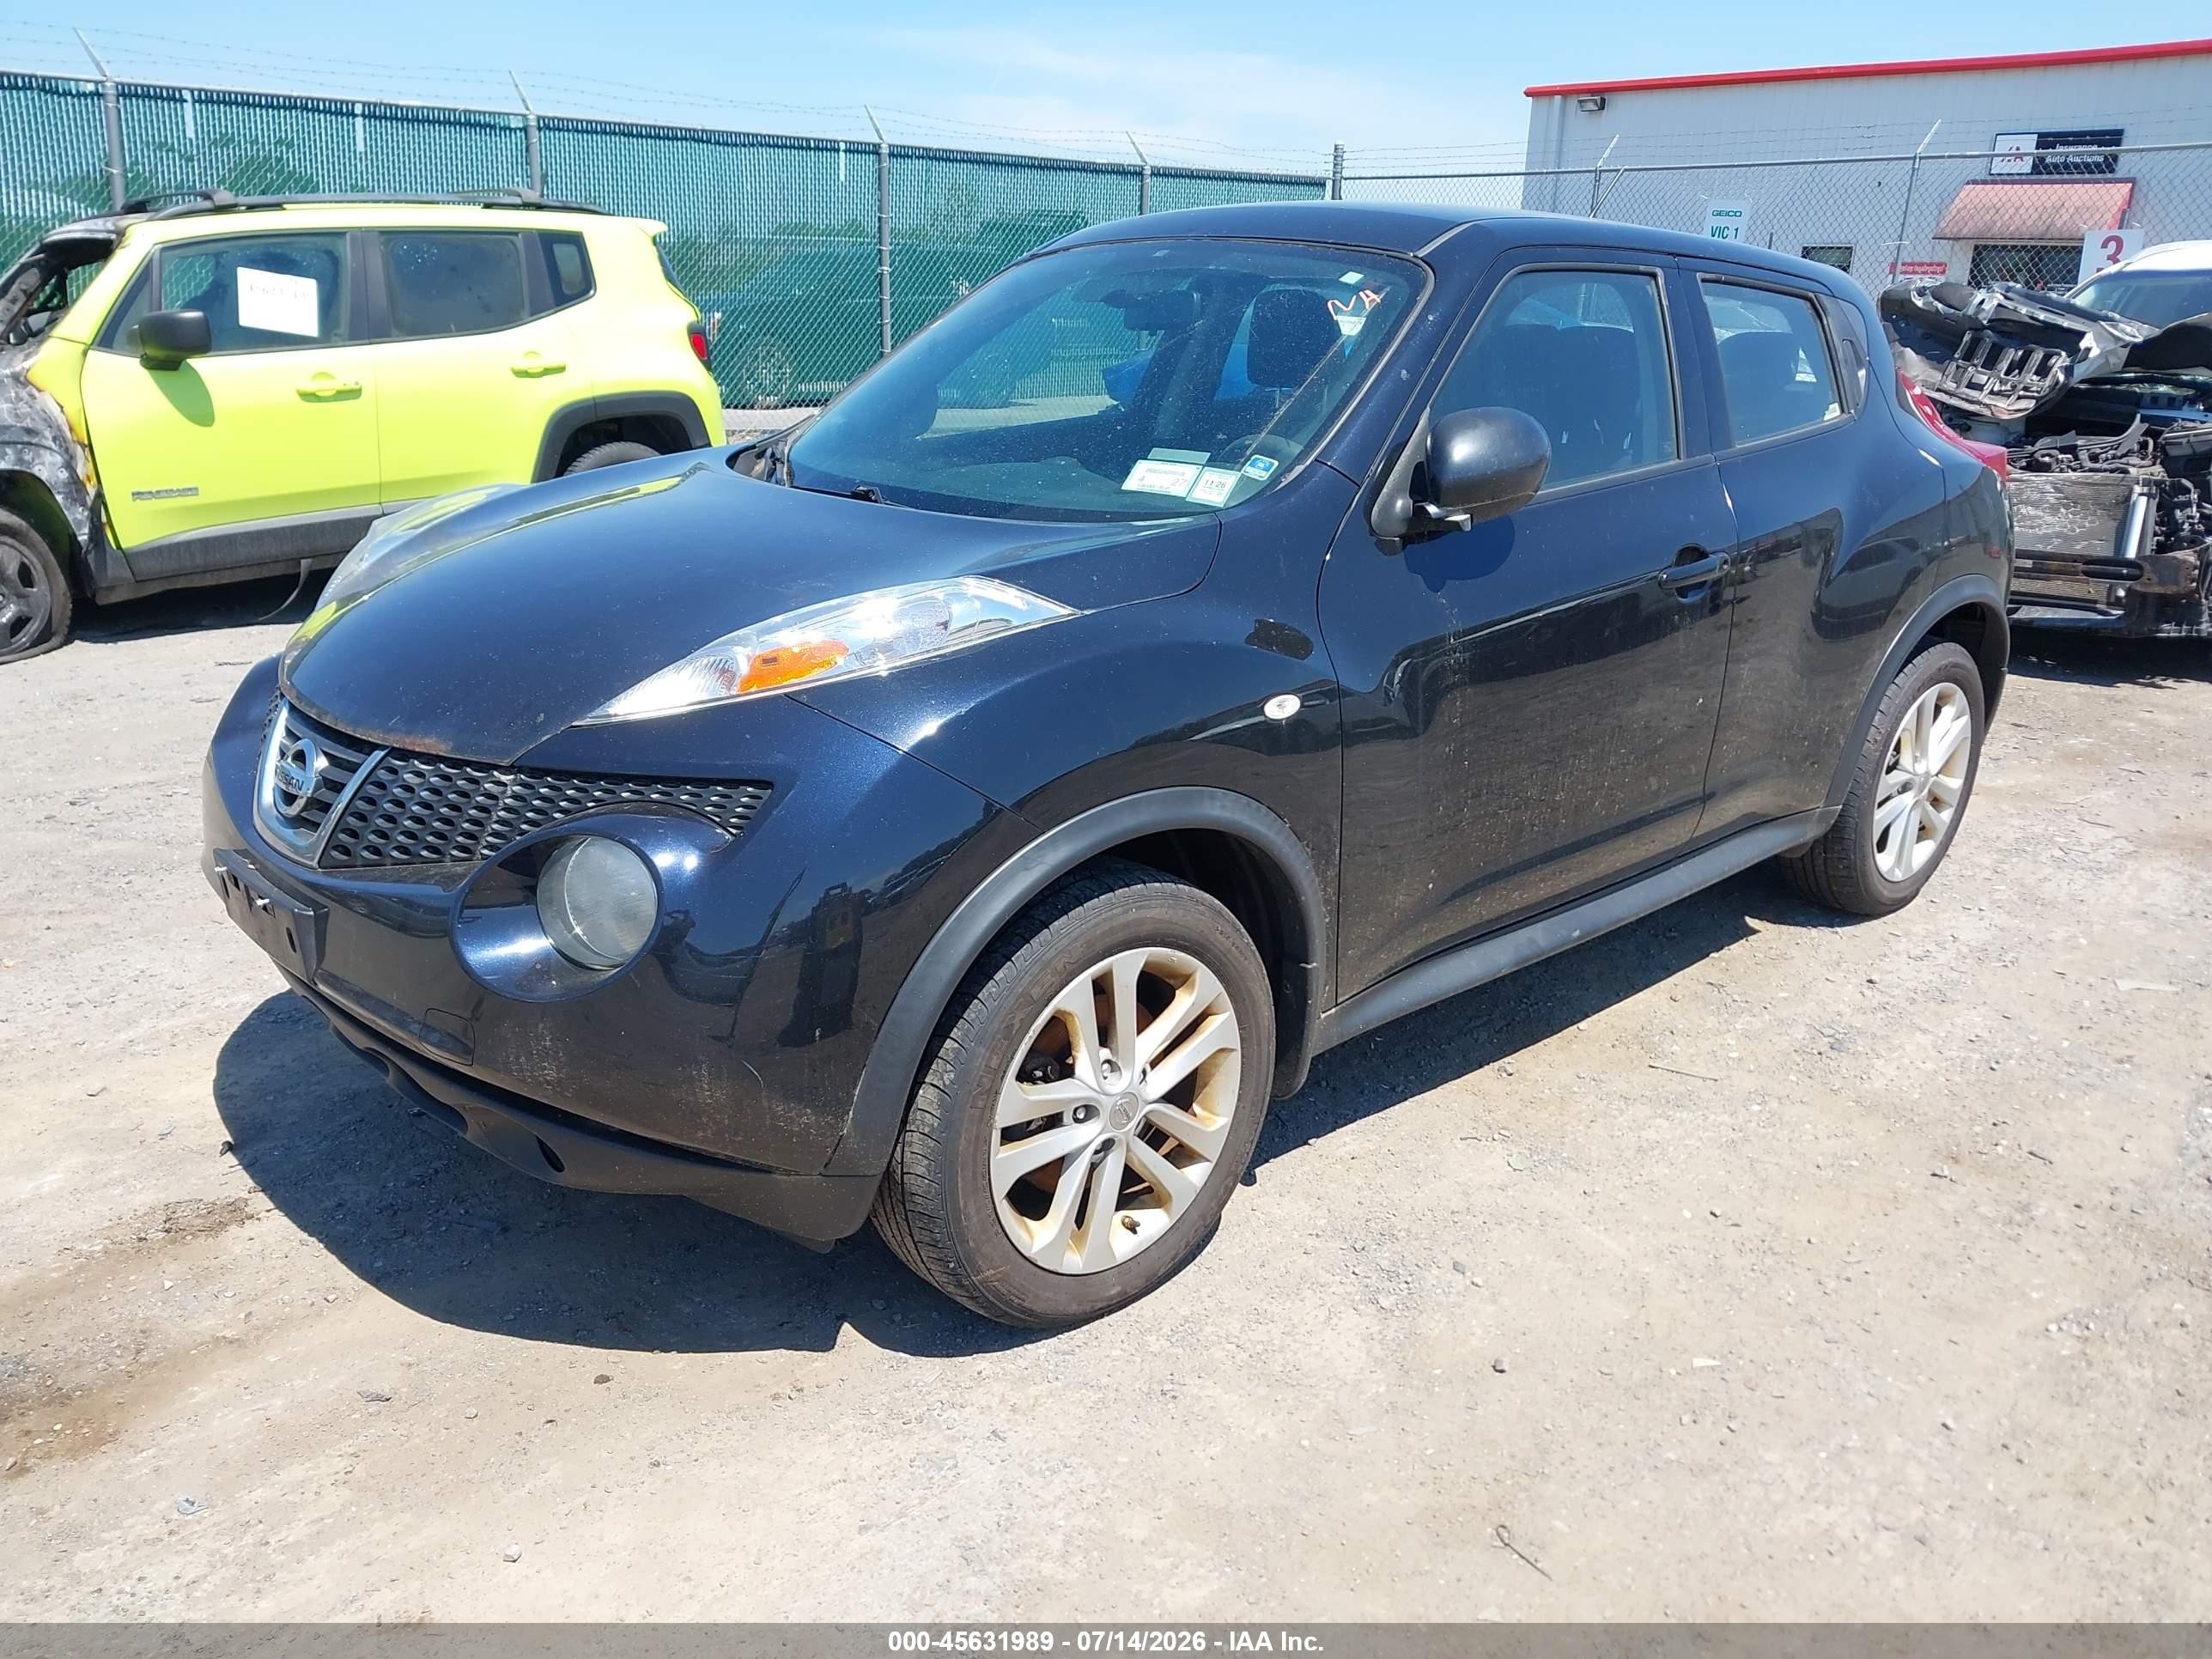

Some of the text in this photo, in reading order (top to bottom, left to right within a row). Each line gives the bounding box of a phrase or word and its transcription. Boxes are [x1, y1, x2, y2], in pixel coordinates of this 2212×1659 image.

[2045, 154, 2105, 163] Auto Auctions
[1711, 225, 1739, 240] VIC 1
[2096, 234, 2124, 273] 3
